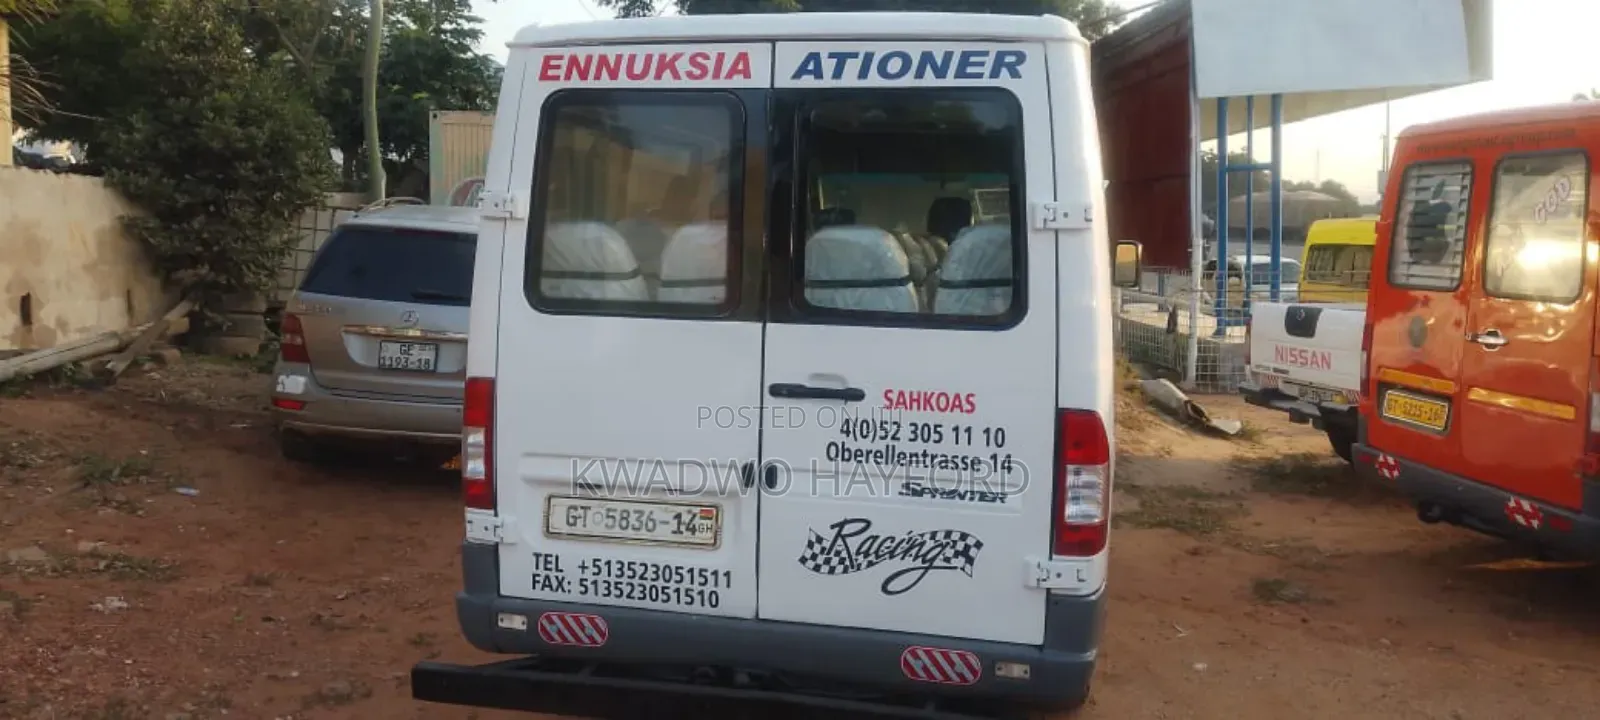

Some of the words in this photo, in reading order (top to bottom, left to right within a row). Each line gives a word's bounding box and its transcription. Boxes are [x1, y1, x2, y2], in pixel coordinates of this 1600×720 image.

[538, 51, 752, 81] ENNUKSIA
[791, 50, 1026, 80] ATIONER
[1274, 344, 1332, 370] NISSAN
[883, 389, 976, 414] SAHKOAS
[840, 418, 901, 444] 4(0)52
[908, 422, 944, 445] 305
[952, 425, 973, 447] 11
[983, 427, 1006, 449] 10
[826, 441, 982, 473] Oberellentrasse
[989, 453, 1013, 475] 14
[566, 505, 591, 528] GT
[604, 507, 697, 536] 5836-14
[698, 524, 713, 534] GH
[532, 552, 564, 573] TEL
[578, 558, 732, 589] +513523051511
[829, 518, 960, 596] Racing
[531, 573, 572, 594] FAX:
[579, 578, 719, 609] 513523051510
